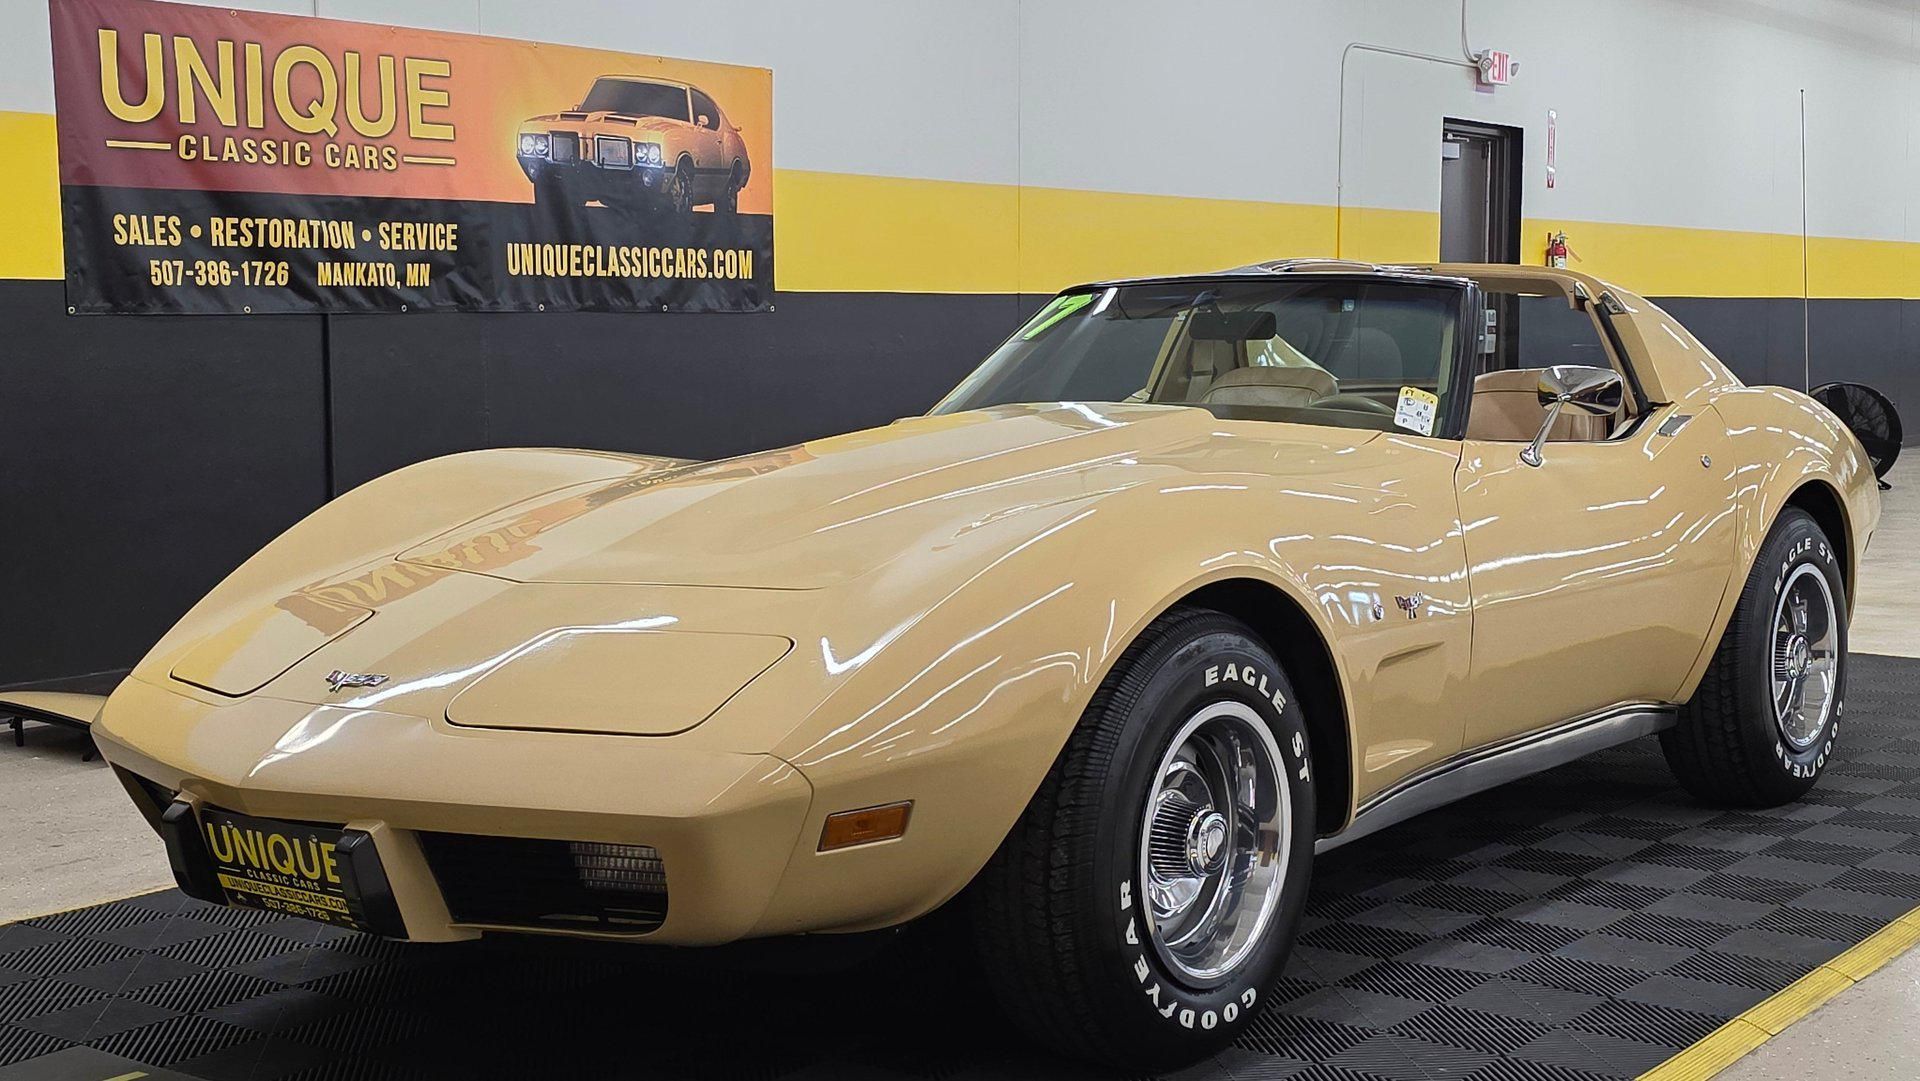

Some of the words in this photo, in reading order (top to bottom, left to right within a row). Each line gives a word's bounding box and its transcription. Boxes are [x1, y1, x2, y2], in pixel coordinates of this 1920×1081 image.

[98, 29, 456, 140] UNIQUE
[1492, 51, 1509, 83] EXIT
[178, 134, 311, 167] CLASSIC
[325, 142, 398, 171] CARS
[113, 213, 182, 247] SALES
[210, 216, 356, 250] RESTORATION
[378, 221, 458, 251] SERVICE
[149, 260, 289, 287] 507-386-1726
[317, 262, 401, 289] MANKATO,
[406, 263, 431, 287] MN
[507, 243, 753, 280] UNIQUECLASSICCARS.COM
[1773, 537, 1812, 595] EAGLE
[1818, 541, 1834, 566] ST
[1205, 663, 1287, 716] EAGLE
[1292, 731, 1311, 784] ST
[1774, 700, 1844, 779] GOODYEAR
[206, 822, 341, 884] UNIQUE
[246, 868, 290, 886] CLASSIC
[292, 878, 321, 891] CARS
[1118, 878, 1258, 1031] GOODYEAR
